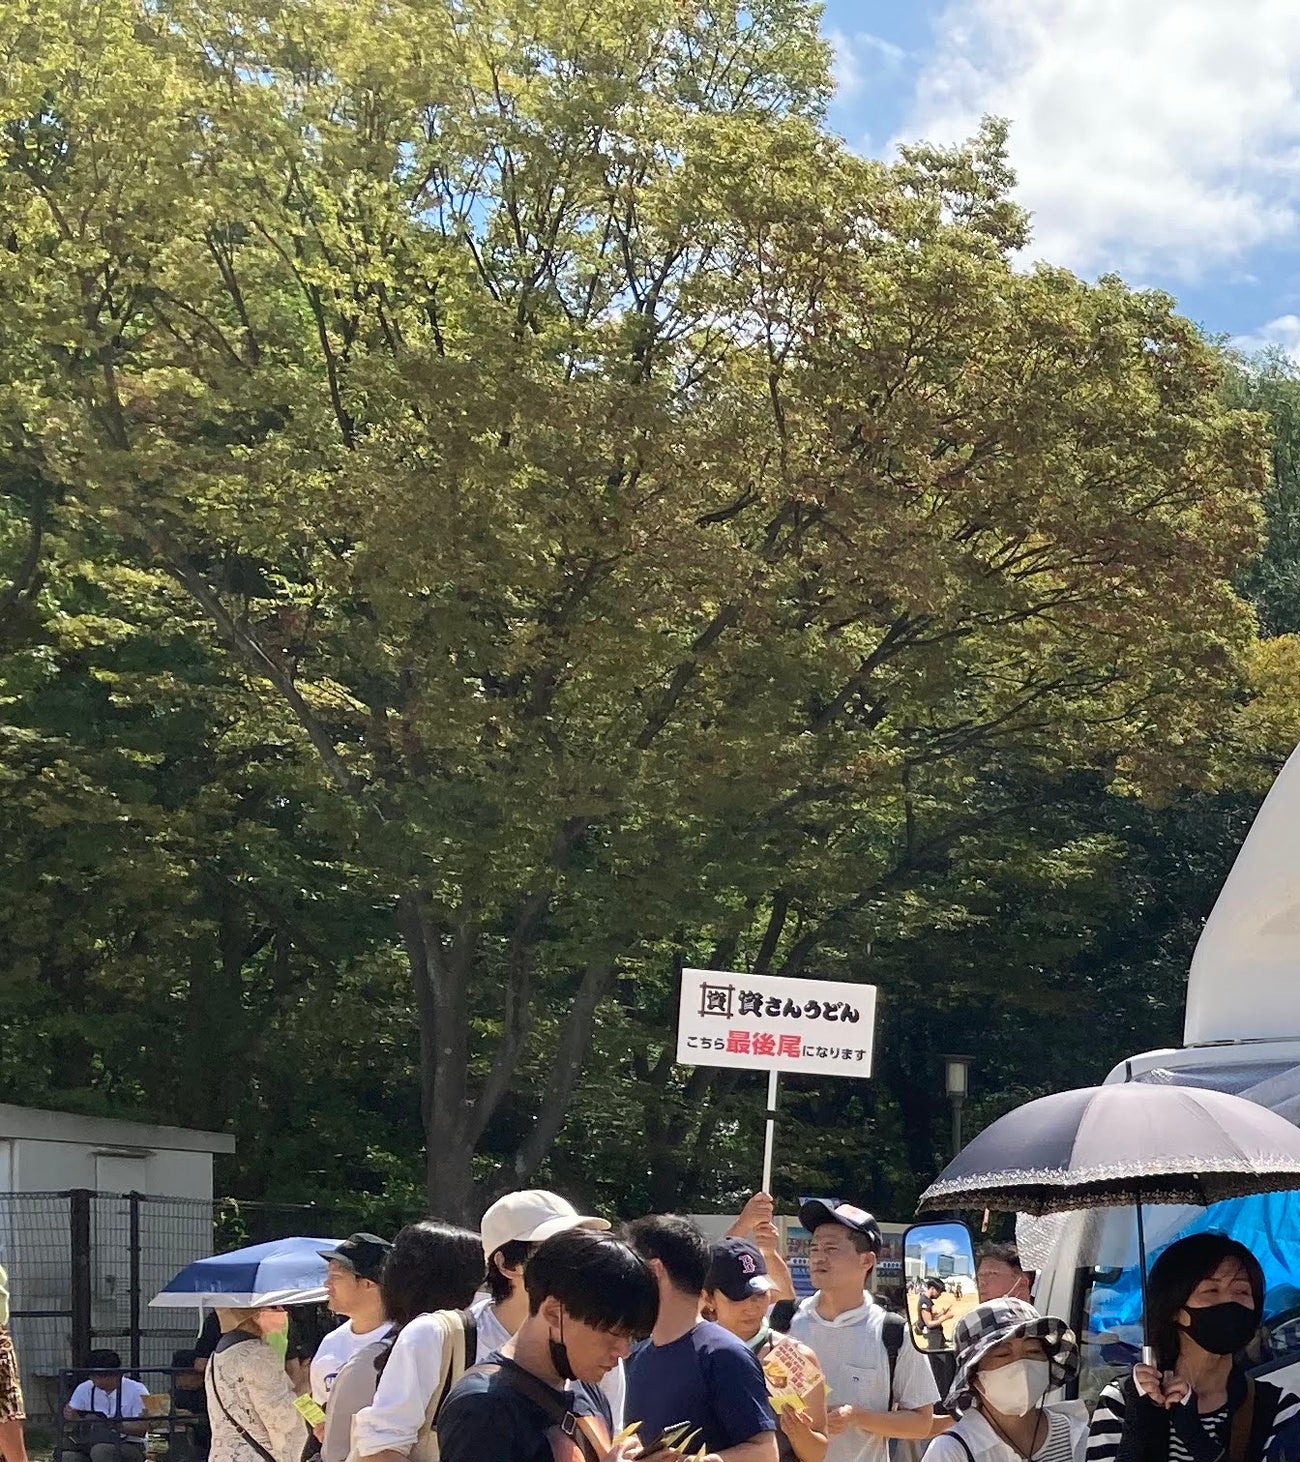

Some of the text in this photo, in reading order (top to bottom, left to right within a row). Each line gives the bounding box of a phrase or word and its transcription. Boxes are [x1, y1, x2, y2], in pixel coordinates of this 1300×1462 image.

[738, 989, 859, 1023] 資さんうどん
[687, 1030, 866, 1061] こちら最後尾になります
[738, 1254, 756, 1274] B
